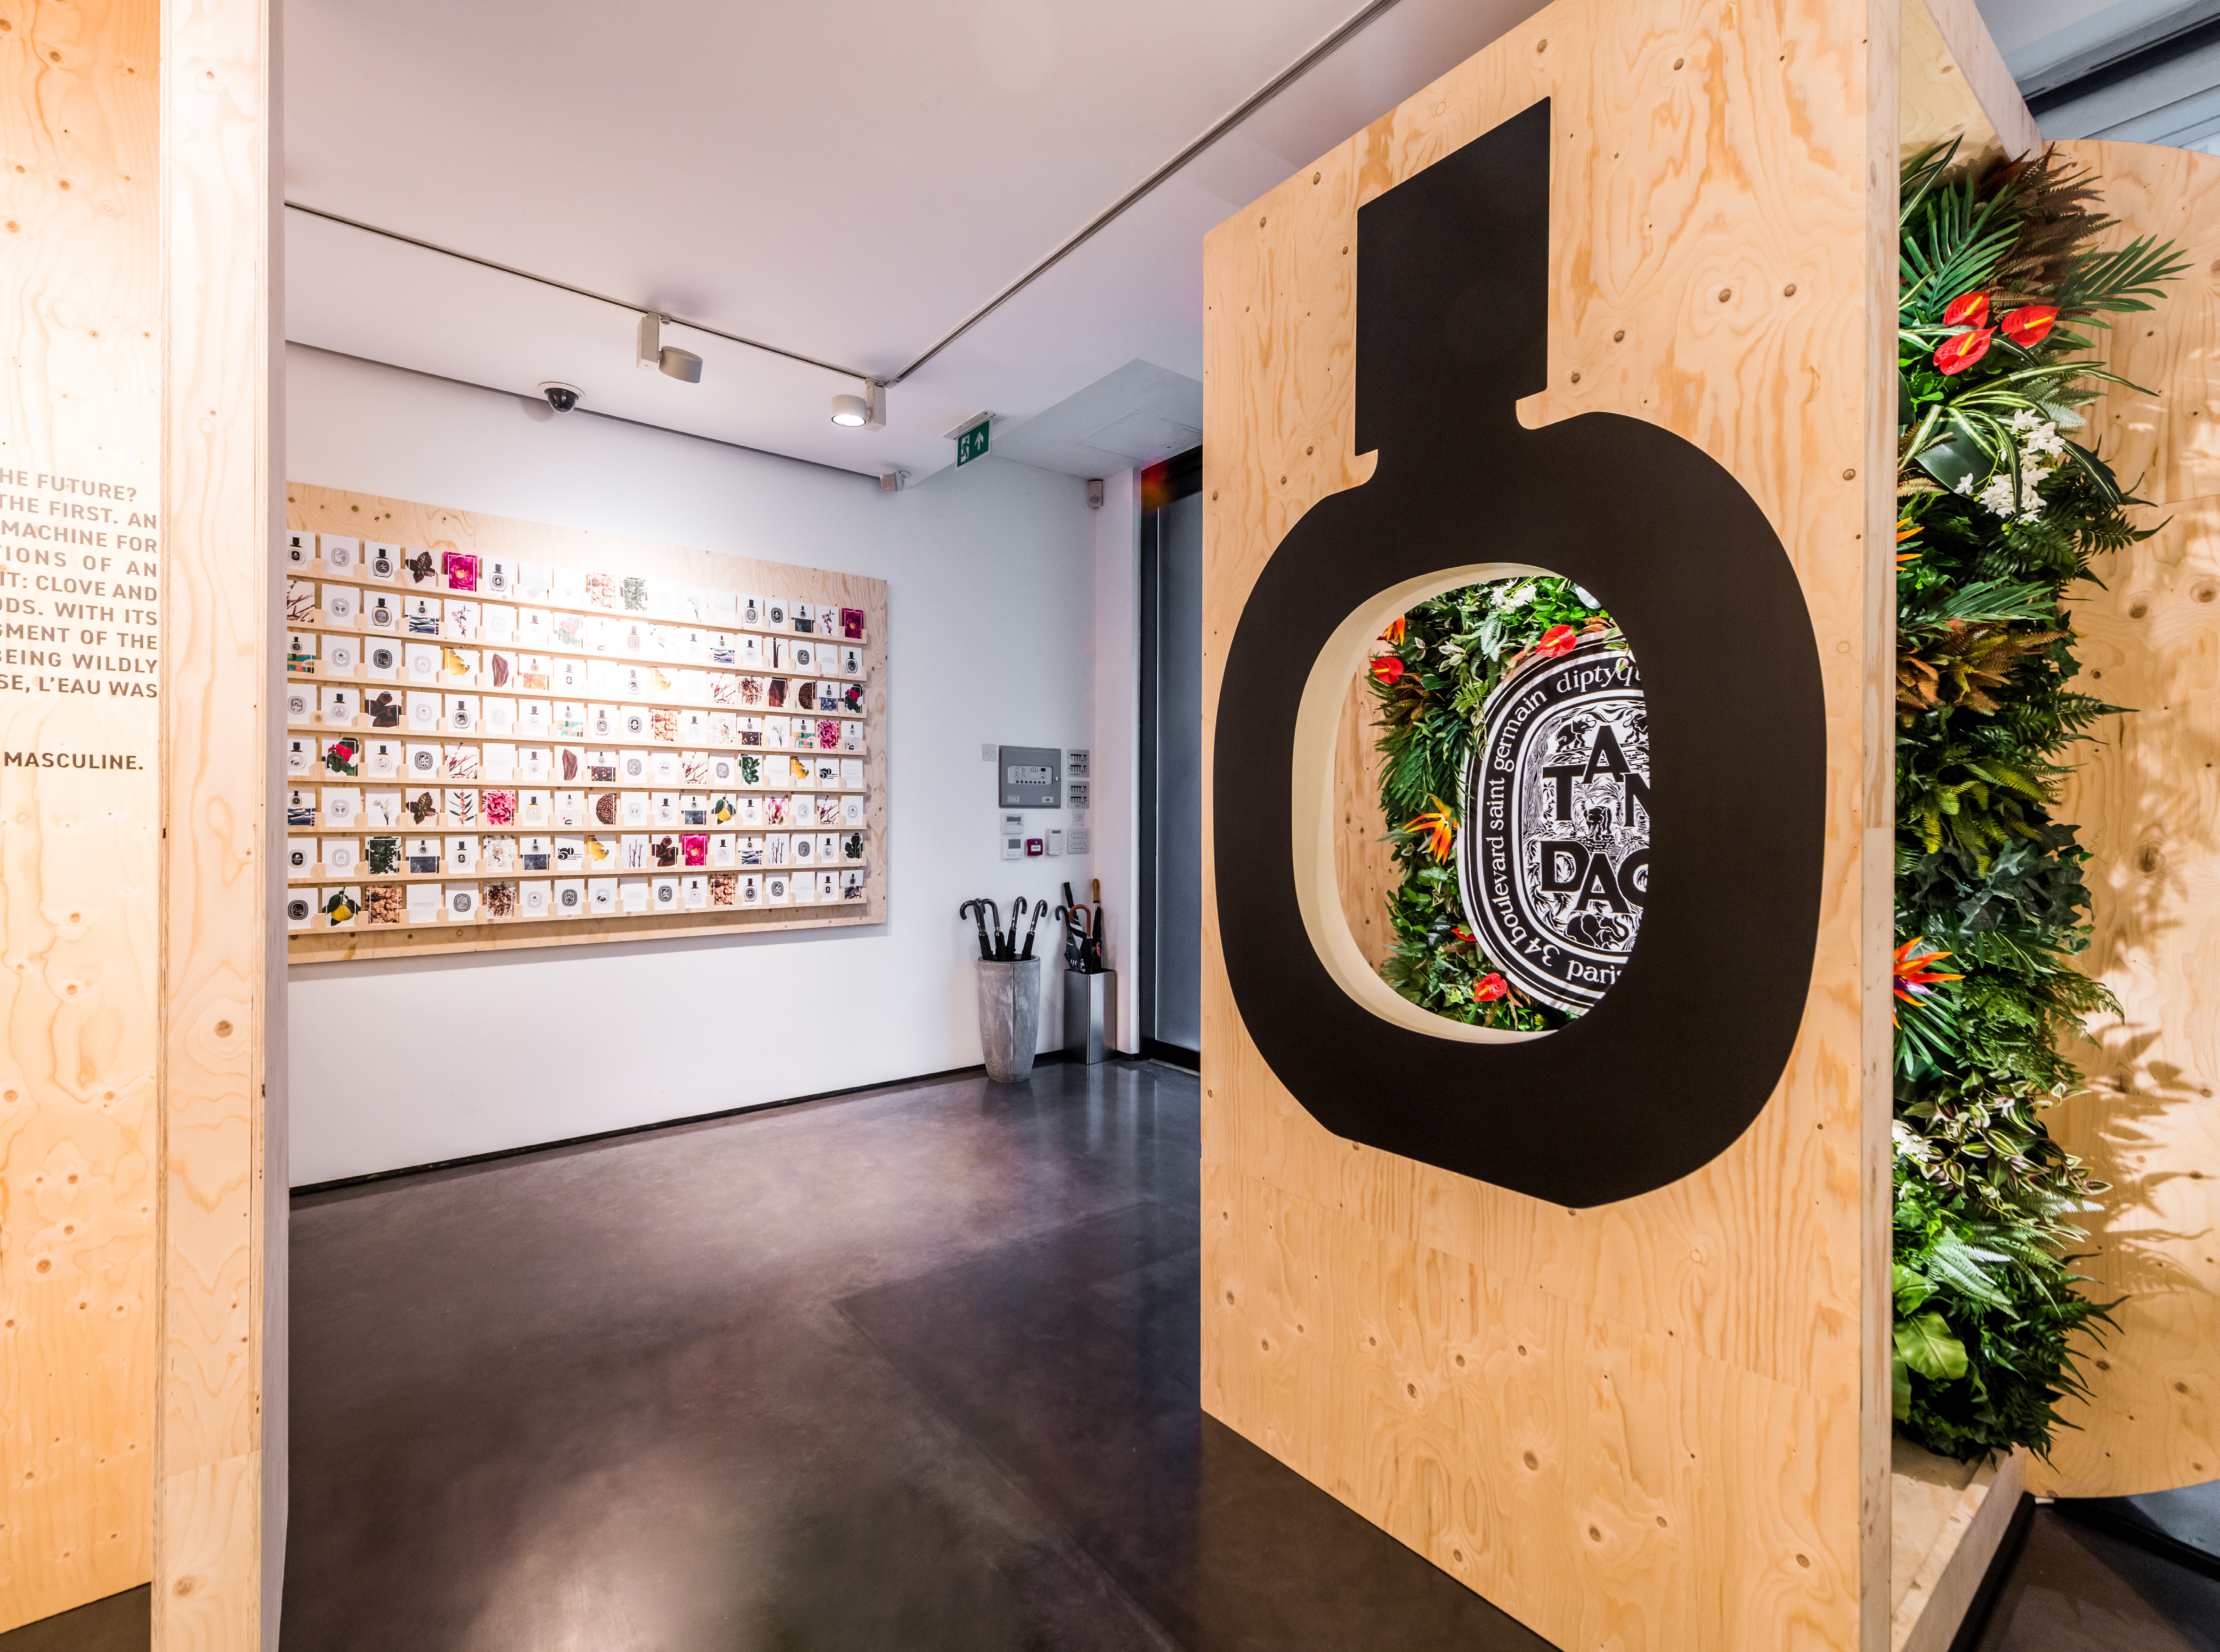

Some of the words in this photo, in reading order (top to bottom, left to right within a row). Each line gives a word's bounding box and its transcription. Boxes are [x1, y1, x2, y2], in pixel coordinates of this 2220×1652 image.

[38, 474, 137, 502] FUTURE?
[50, 501, 118, 524] FIRST.
[128, 512, 156, 529] AN
[1, 520, 107, 547] MACHINE
[117, 534, 157, 554] FOR
[0, 545, 66, 567] IONS
[83, 555, 111, 572] OF
[126, 561, 156, 577] AN
[36, 575, 105, 596] CLOVE
[112, 584, 157, 601] AND
[0, 597, 43, 615] DS.
[54, 602, 113, 622] WITH
[125, 609, 157, 625] ITS
[0, 623, 70, 642] MENT
[81, 630, 107, 645] OF
[117, 632, 157, 650] THE
[0, 649, 61, 667] EING
[72, 653, 157, 673] WILDLY
[39, 677, 100, 694] L'EAU
[108, 681, 157, 697] WAS
[1494, 690, 1548, 772] germain
[4, 751, 143, 770] MASCULINE.
[819, 768, 832, 778] 50
[1487, 777, 1505, 830] saint
[558, 847, 574, 860] 50
[1485, 835, 1528, 946] boulevard
[1524, 937, 1560, 966] 34
